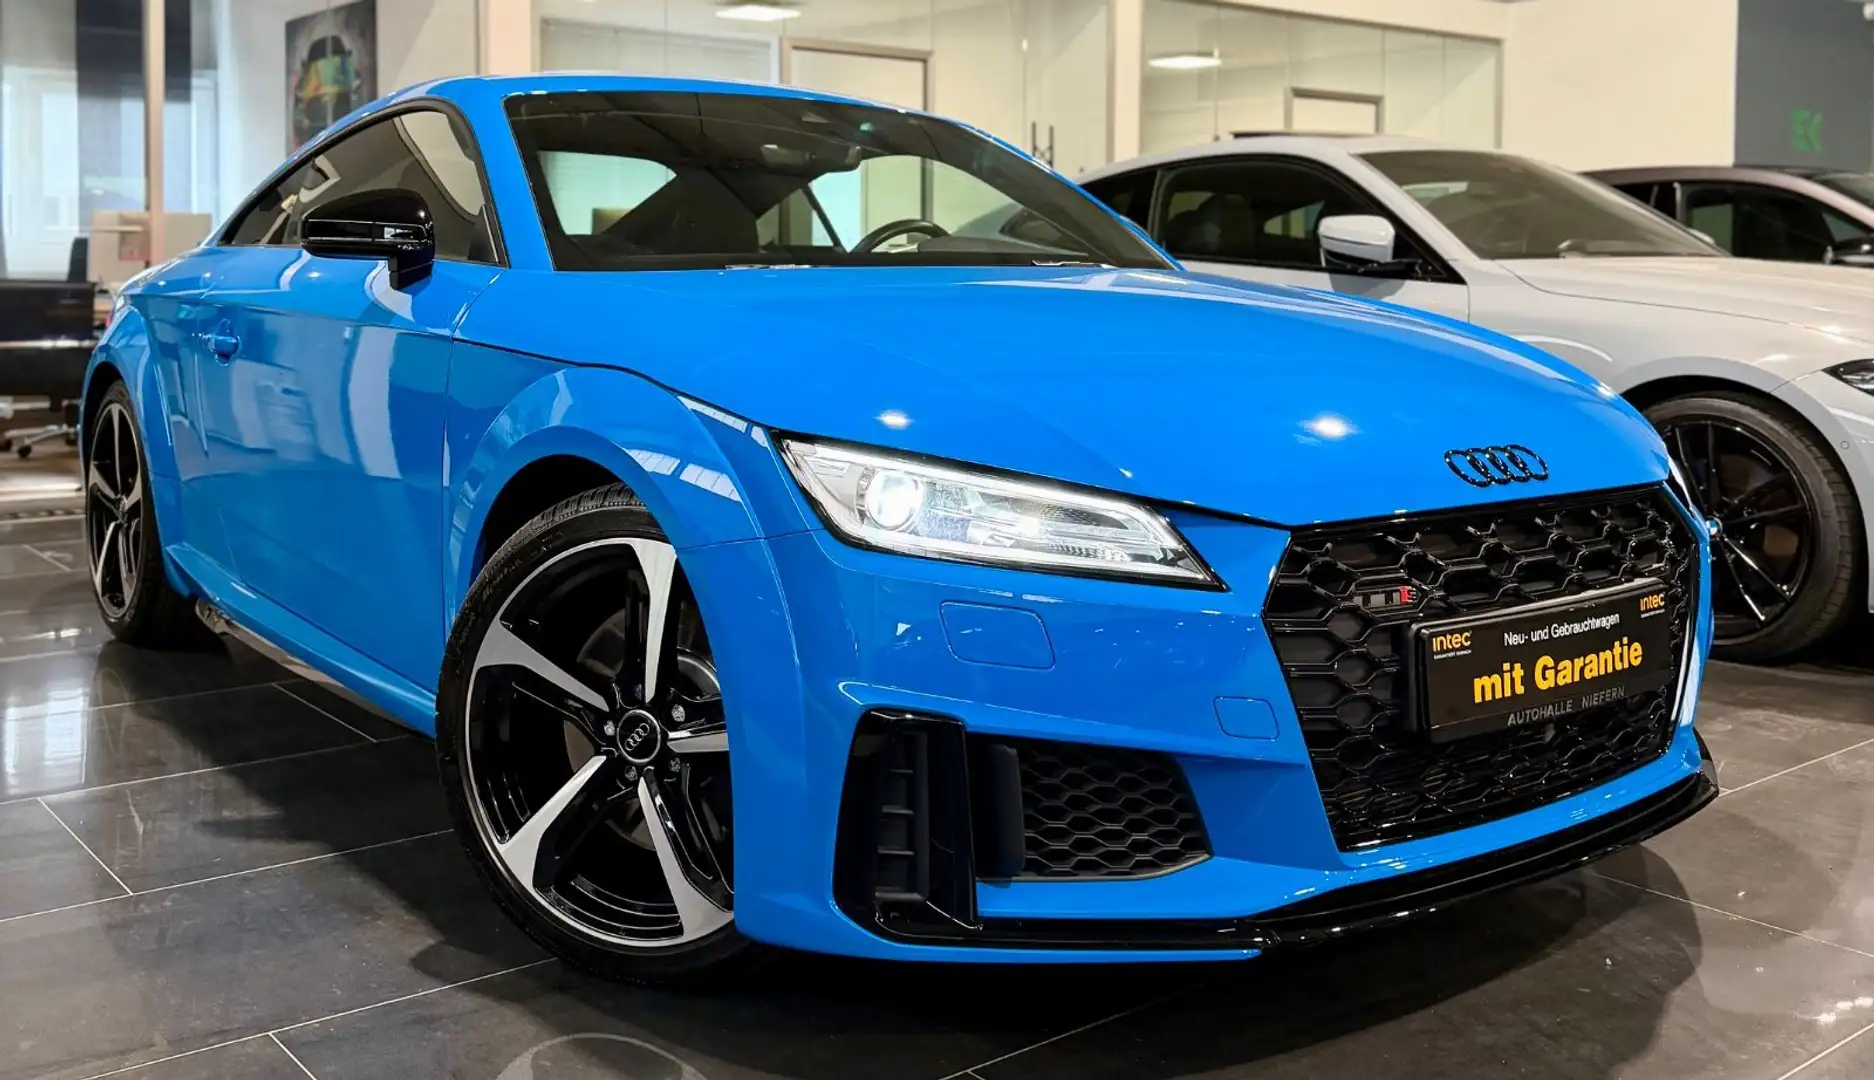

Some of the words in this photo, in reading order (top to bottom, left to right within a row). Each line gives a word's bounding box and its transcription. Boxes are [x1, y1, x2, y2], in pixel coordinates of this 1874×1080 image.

[1504, 632, 1528, 647] Neu-
[1531, 626, 1549, 642] und
[1551, 613, 1620, 638] Gebrauchtwagen
[1474, 662, 1525, 703] mit
[1534, 636, 1643, 690] Garantie
[1507, 700, 1573, 726] AUTOHALLE
[1582, 686, 1626, 709] NIEFERN
